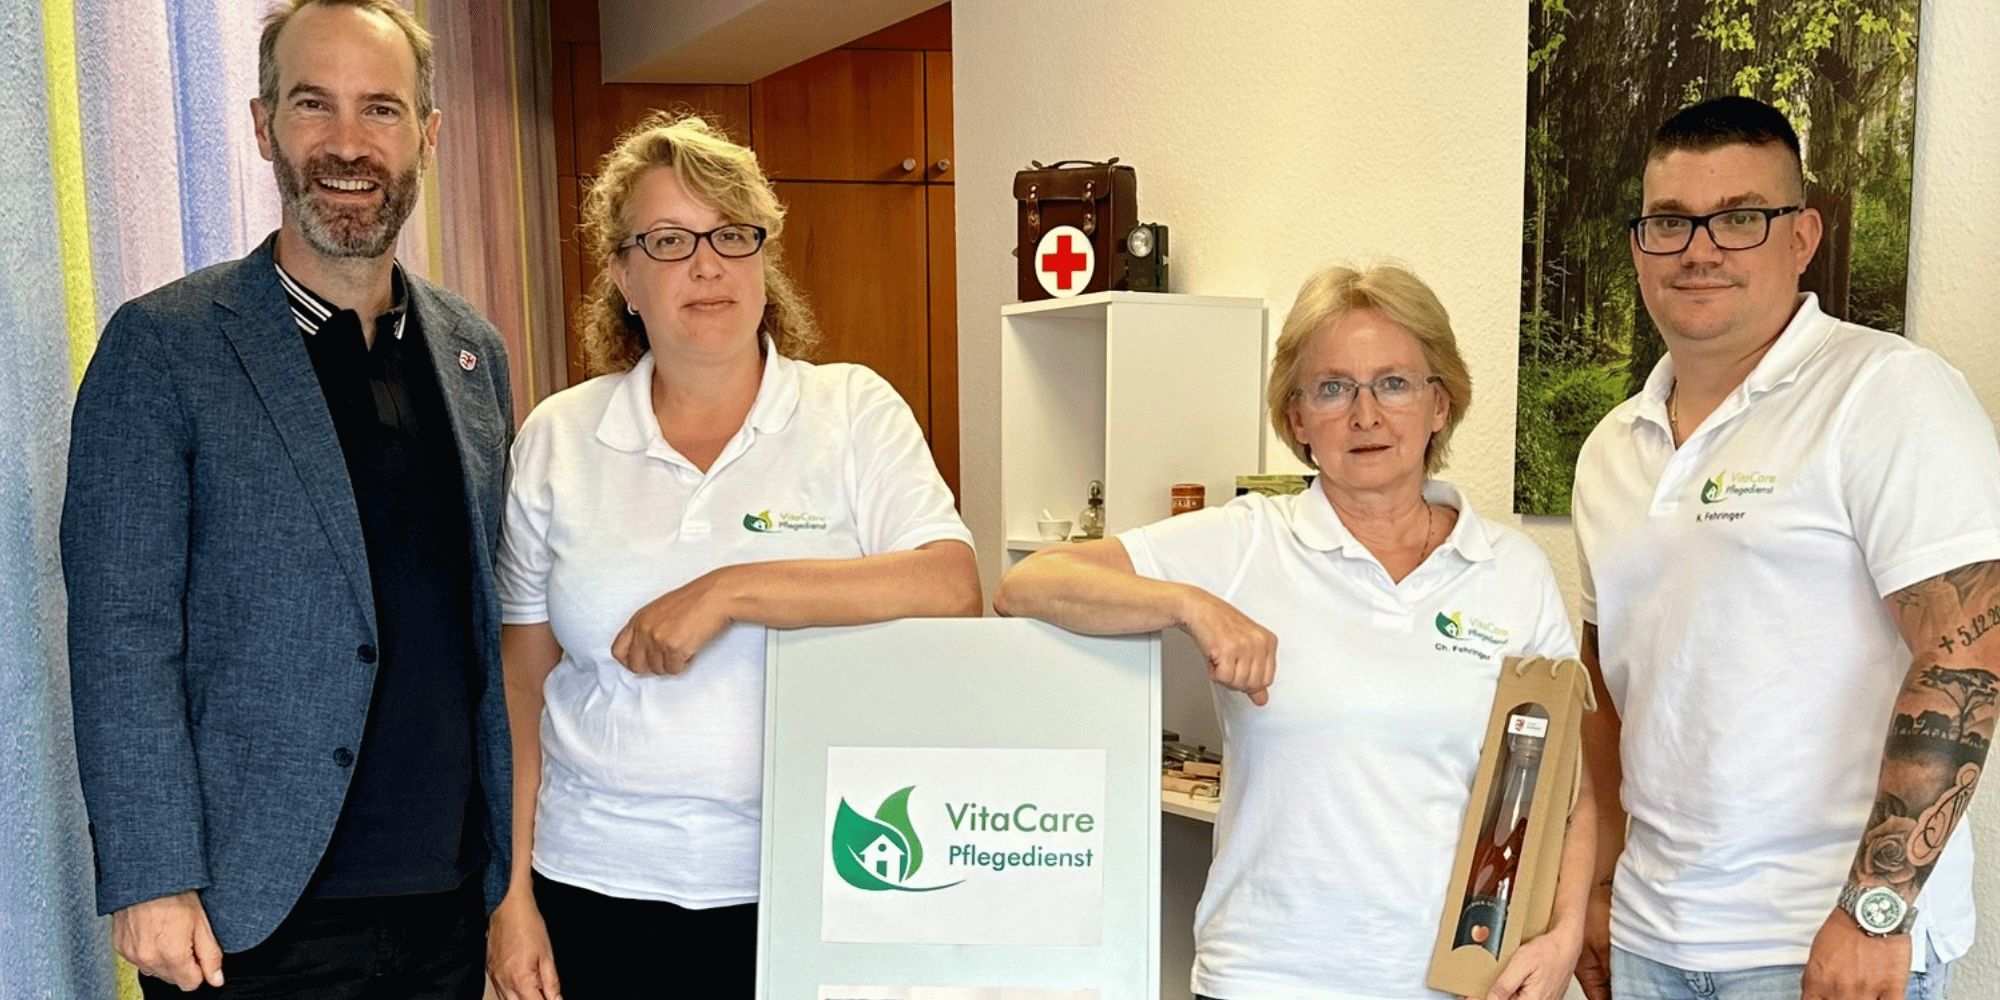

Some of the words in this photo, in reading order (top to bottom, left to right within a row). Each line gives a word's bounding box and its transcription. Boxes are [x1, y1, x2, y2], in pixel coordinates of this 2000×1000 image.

[1732, 471, 1776, 483] VitaCare
[1726, 484, 1774, 496] Pflegedienst
[780, 512, 826, 522] VitaCare
[1704, 511, 1746, 522] Fehringer
[778, 521, 827, 532] Pflegedienst
[1469, 617, 1509, 637] VitaCare
[1468, 628, 1509, 645] Pflegedienst
[1452, 645, 1491, 661] Fehringer
[944, 802, 1096, 834] VitaCare
[948, 844, 1095, 873] Pflegedienst
